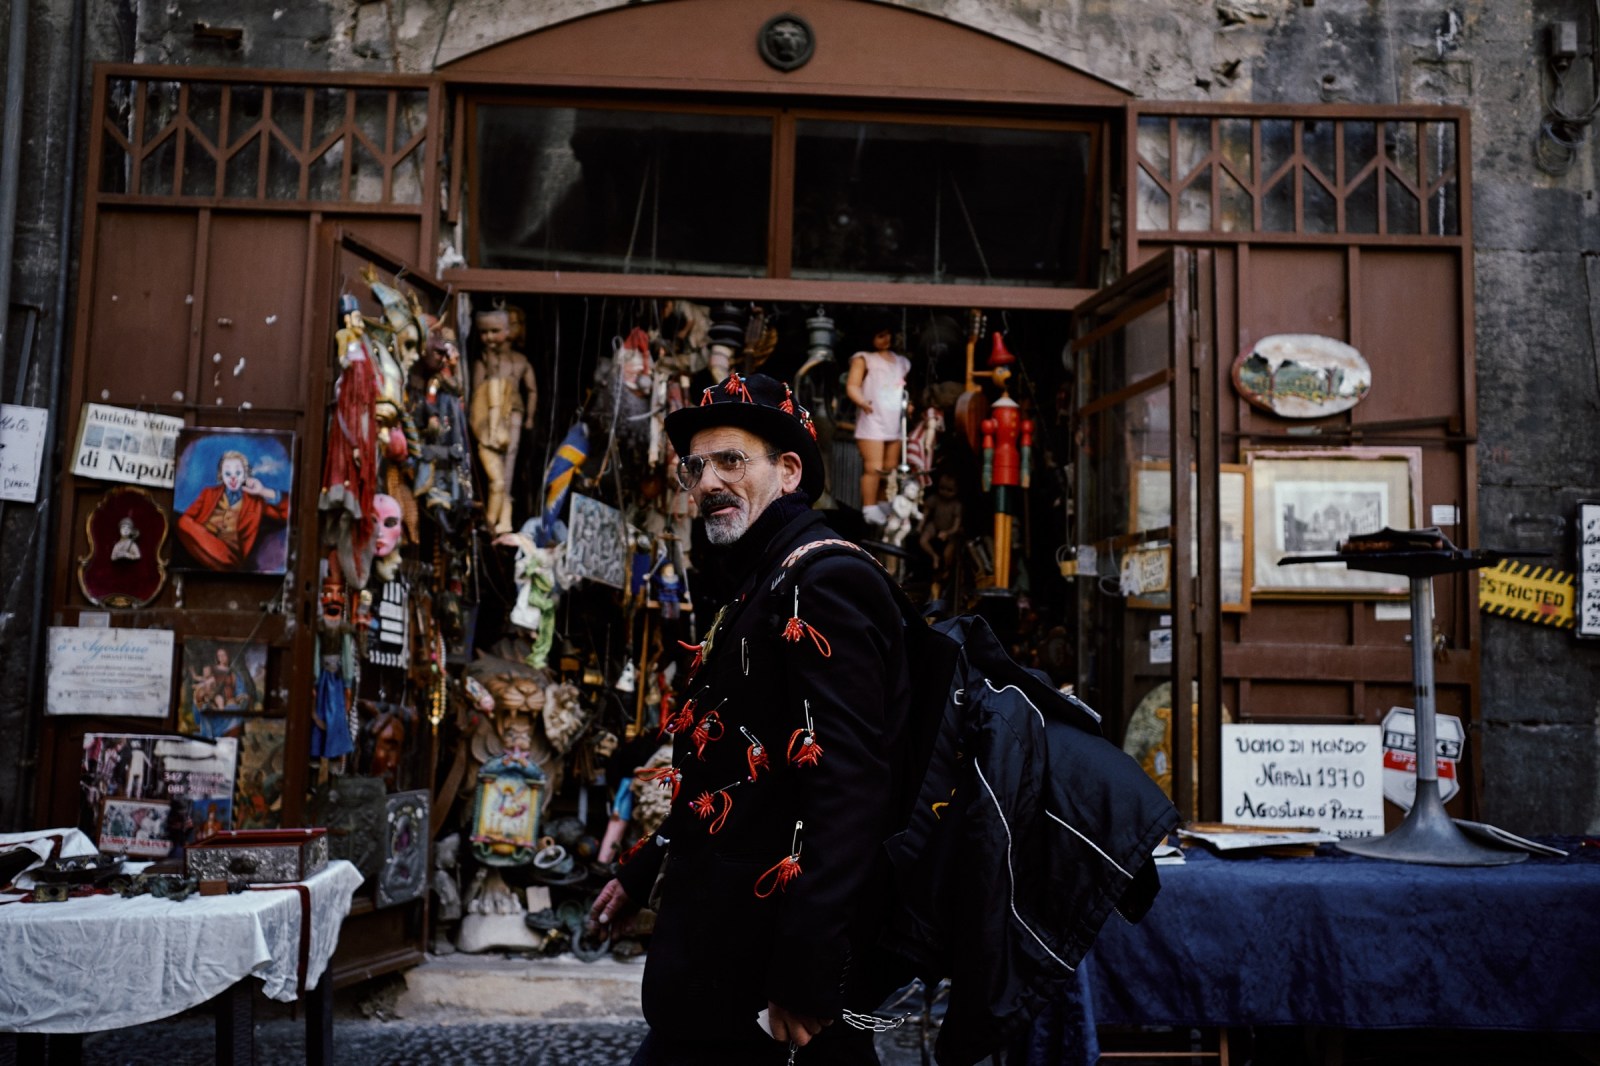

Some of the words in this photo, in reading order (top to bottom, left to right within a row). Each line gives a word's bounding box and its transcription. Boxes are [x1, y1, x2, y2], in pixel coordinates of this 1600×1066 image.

[90, 409, 138, 426] Antiche
[80, 450, 99, 468] di
[109, 454, 175, 480] Napoli
[1235, 738, 1285, 754] UOMO
[1289, 740, 1304, 754] DI
[1311, 739, 1368, 754] MONDO
[1317, 767, 1365, 789] 1970
